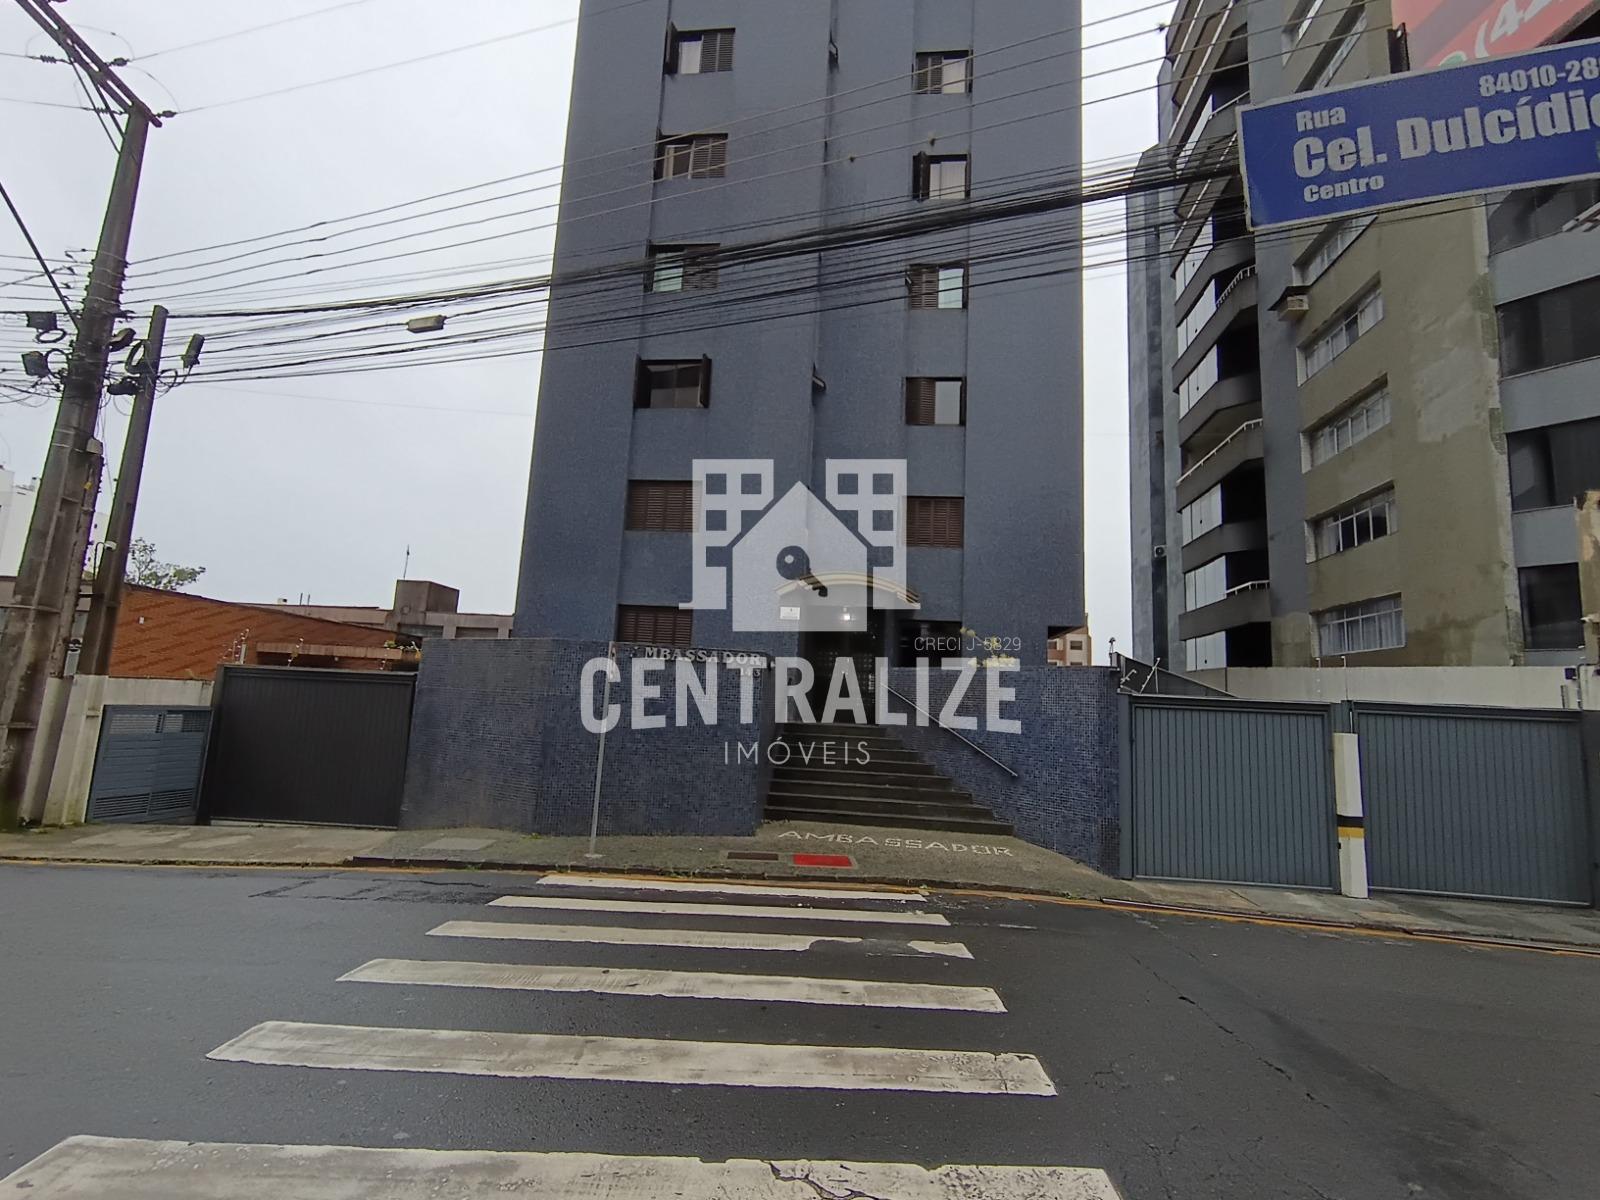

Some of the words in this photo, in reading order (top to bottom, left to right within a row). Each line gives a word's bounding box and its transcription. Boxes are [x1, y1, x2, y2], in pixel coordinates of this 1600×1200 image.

[1479, 56, 1600, 97] 84010-28
[1296, 106, 1346, 132] Rua
[1293, 125, 1388, 178] Cel.
[1303, 174, 1385, 202] Centro
[778, 830, 1014, 857] AMBASSADOR
